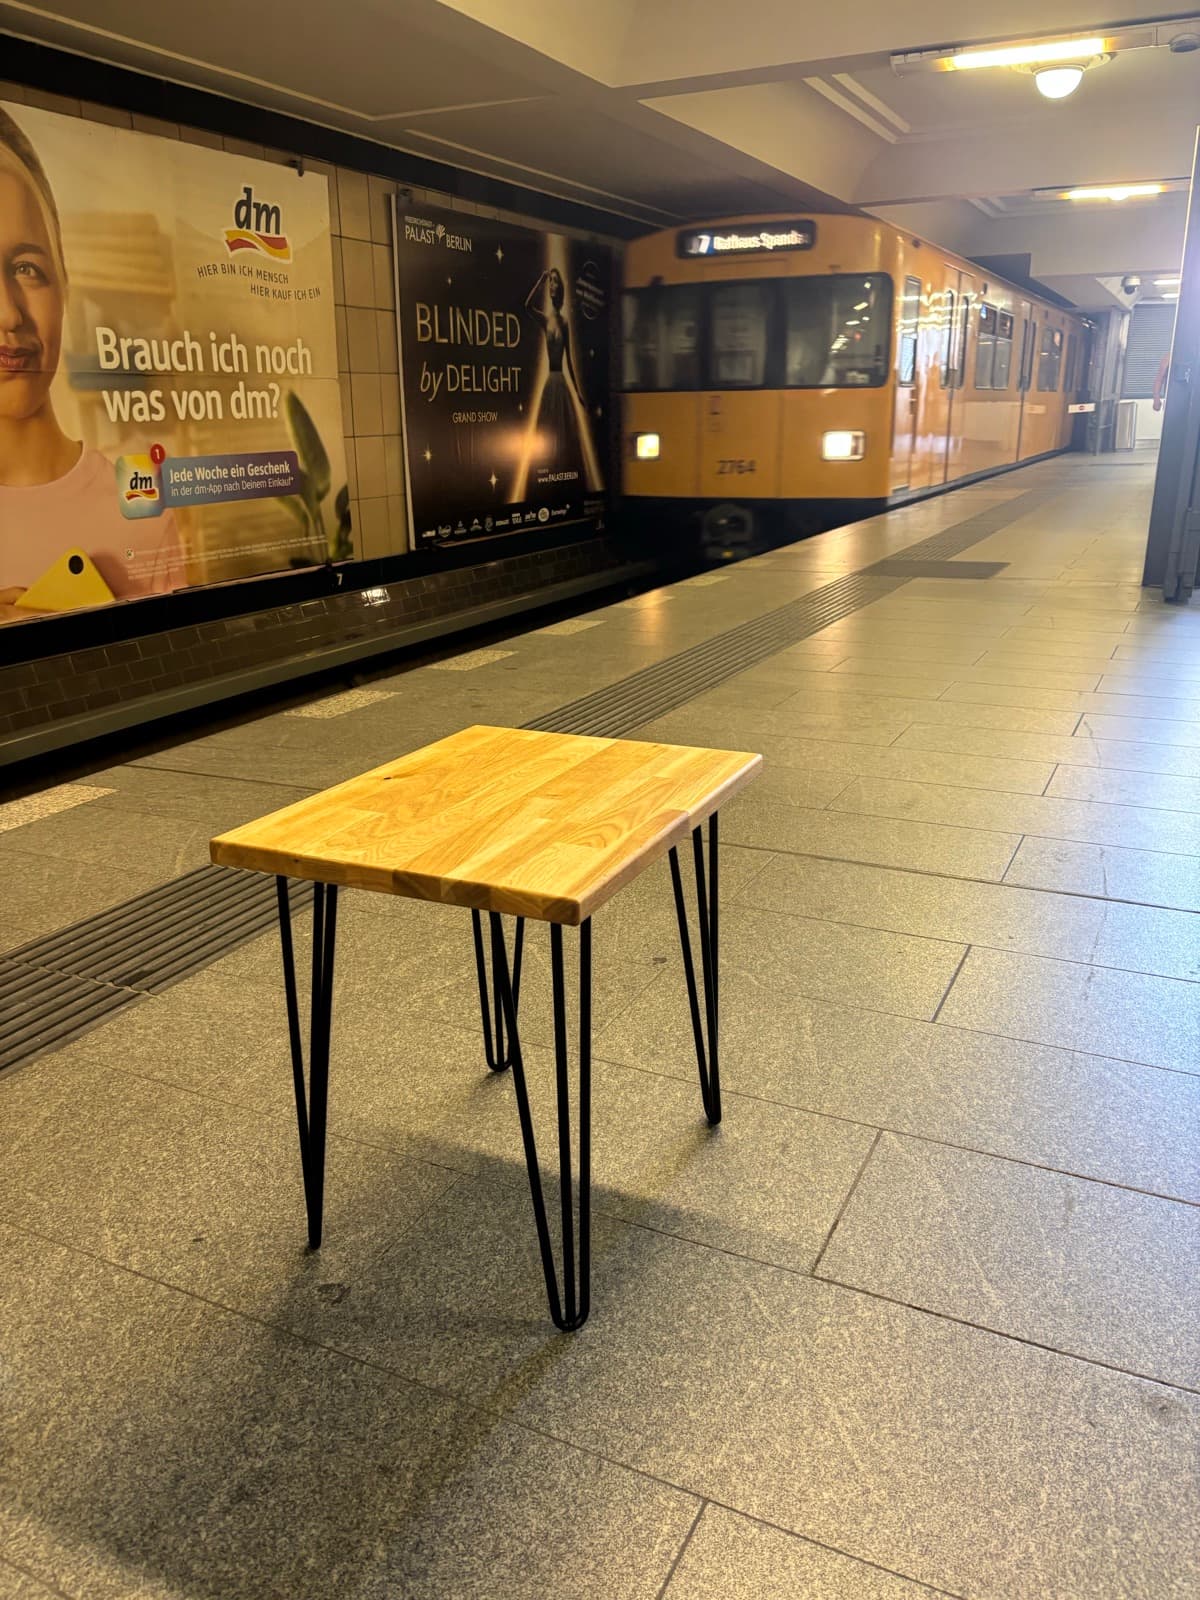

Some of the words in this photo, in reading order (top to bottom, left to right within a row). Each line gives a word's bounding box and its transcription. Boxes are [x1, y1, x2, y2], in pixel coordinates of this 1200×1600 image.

[234, 186, 281, 235] dm
[404, 224, 436, 245] PALAST
[446, 233, 473, 252] BERLIN
[197, 264, 219, 278] HIER
[220, 263, 236, 275] BIN
[239, 264, 253, 277] ICH
[256, 268, 289, 285] MENSCH
[250, 284, 270, 298] HIER
[272, 287, 292, 301] KAUF
[294, 291, 307, 301] ICH
[308, 287, 321, 300] EIN
[416, 302, 521, 348] BLINDED
[95, 326, 204, 372] Brauch
[209, 331, 249, 373] ich
[255, 338, 313, 375] noch
[420, 361, 443, 402] by
[446, 364, 522, 393] DELIGHT
[101, 389, 166, 423] was
[170, 389, 223, 420] von
[229, 381, 281, 420] dm?
[452, 411, 477, 424] GRAND
[477, 410, 498, 423] SHOW
[169, 468, 193, 484] Jede
[194, 465, 229, 482] Woche
[230, 463, 246, 478] ein
[247, 460, 291, 477] Geschenk
[716, 458, 757, 475] 2764
[129, 471, 153, 490] dm
[180, 484, 193, 497] der
[194, 482, 223, 495] dm-App
[223, 480, 241, 492] nach
[241, 479, 268, 491] Deinem
[336, 572, 343, 586] 7
